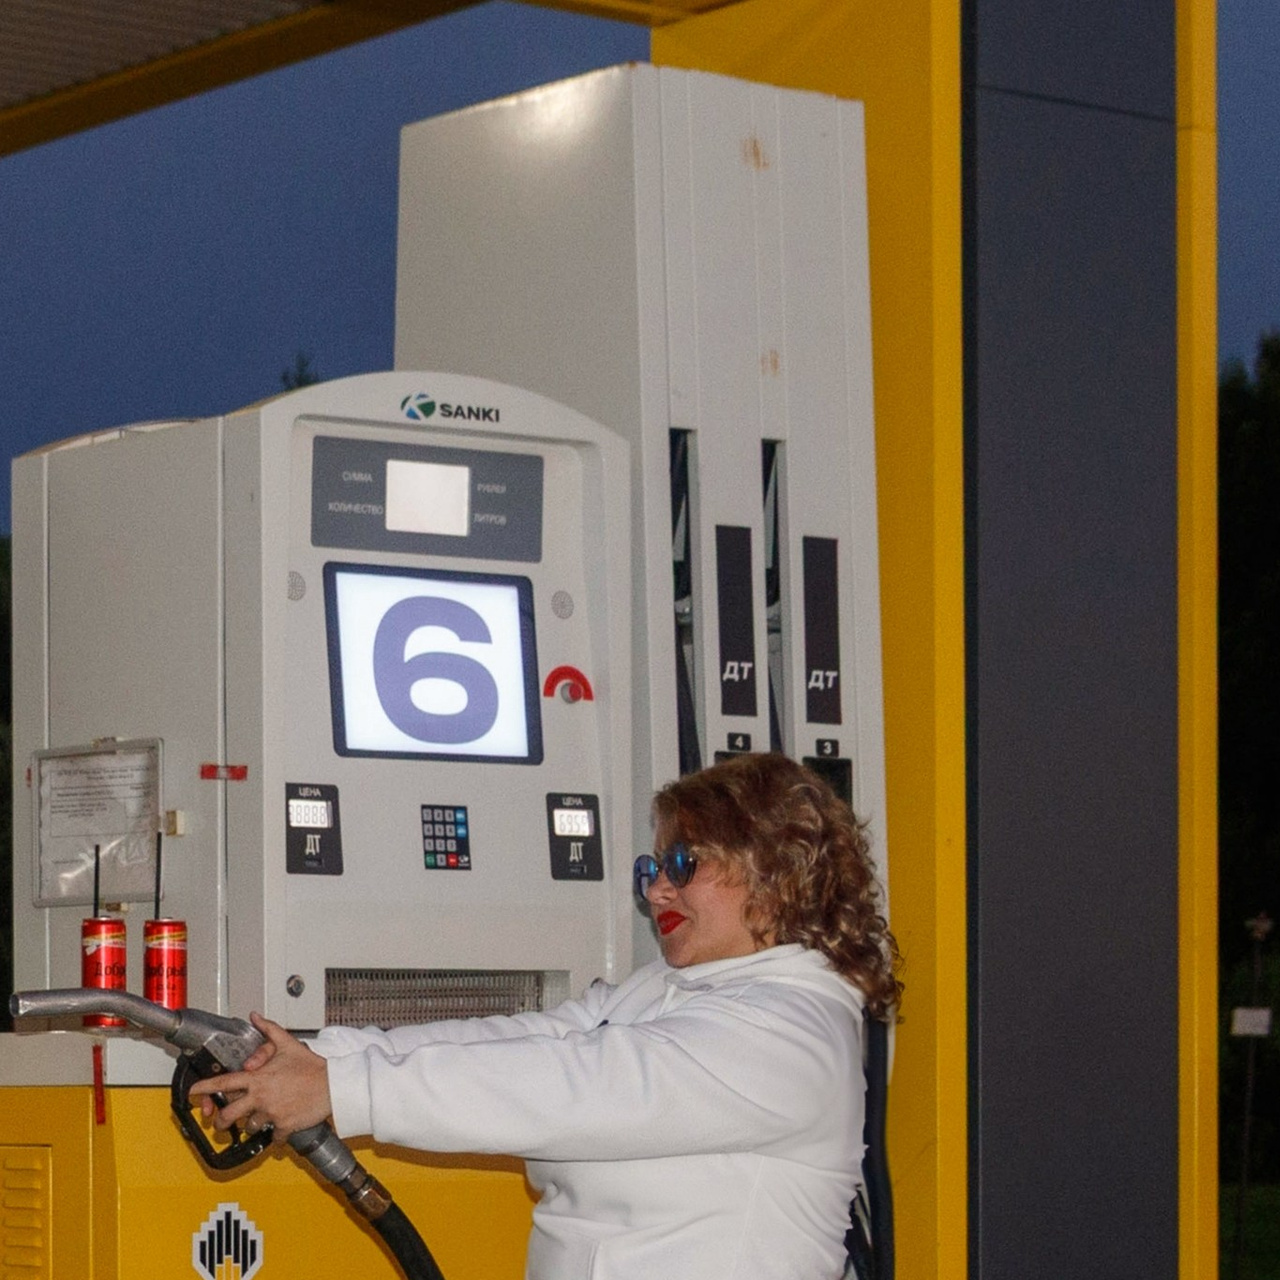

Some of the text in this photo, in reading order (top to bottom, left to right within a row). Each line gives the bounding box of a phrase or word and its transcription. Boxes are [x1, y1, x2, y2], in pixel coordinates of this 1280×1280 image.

[439, 403, 500, 423] SANKI
[372, 594, 500, 745] 6
[722, 660, 753, 682] ДТ
[808, 670, 838, 690] ДТ
[734, 736, 744, 748] 4
[823, 742, 833, 754] 3
[298, 787, 322, 797] ЦЕНА
[562, 797, 584, 807] ЦЕНА
[305, 833, 322, 856] ДТ
[569, 842, 584, 863] ДТ
